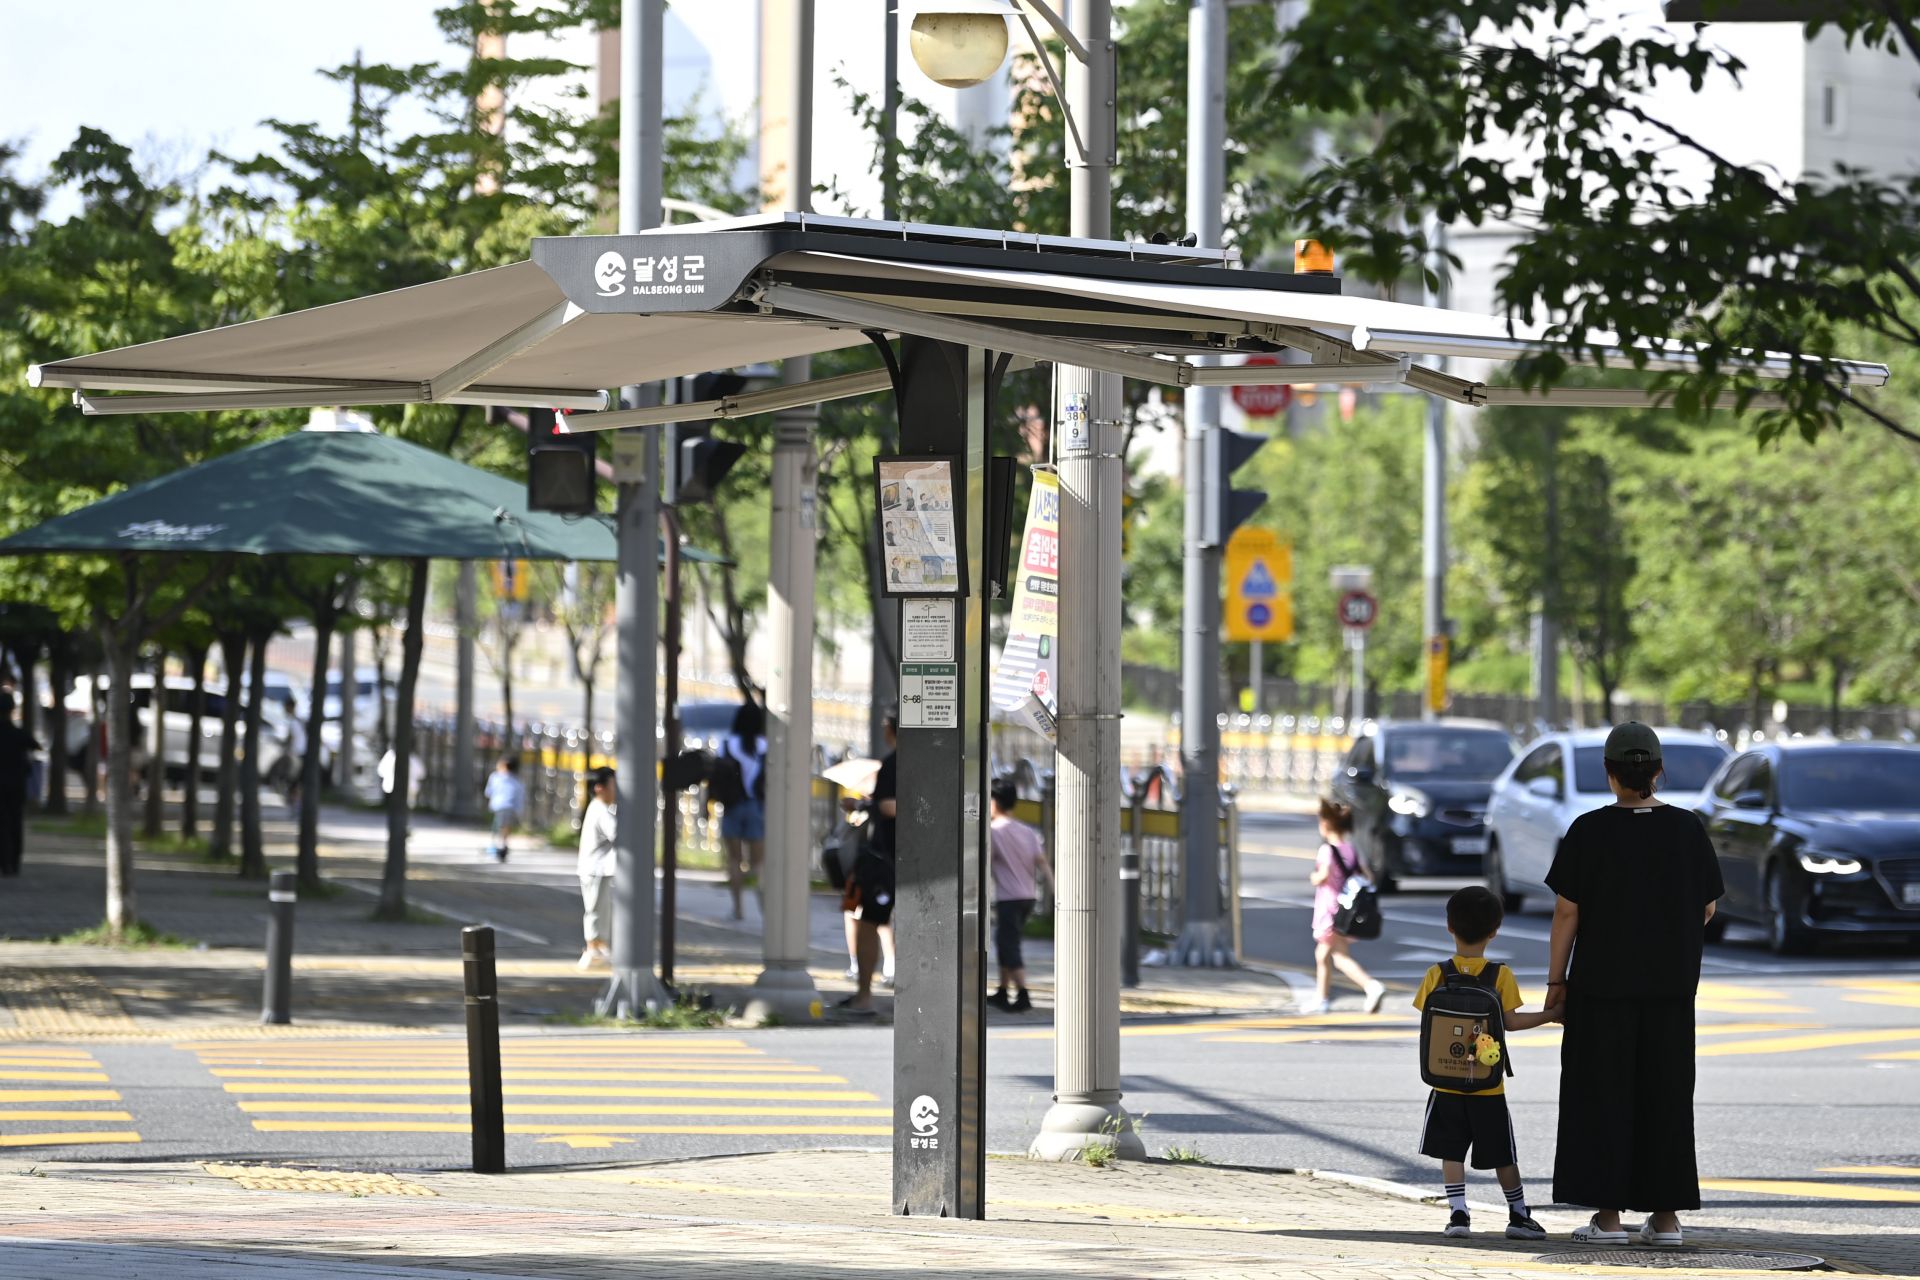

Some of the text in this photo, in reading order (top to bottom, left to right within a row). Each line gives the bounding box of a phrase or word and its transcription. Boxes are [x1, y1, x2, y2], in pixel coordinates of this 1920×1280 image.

[633, 255, 705, 282] 달성군
[633, 285, 705, 295] DALSEONG GUN
[902, 694, 922, 704] S-68
[910, 1138, 939, 1149] 달성군
